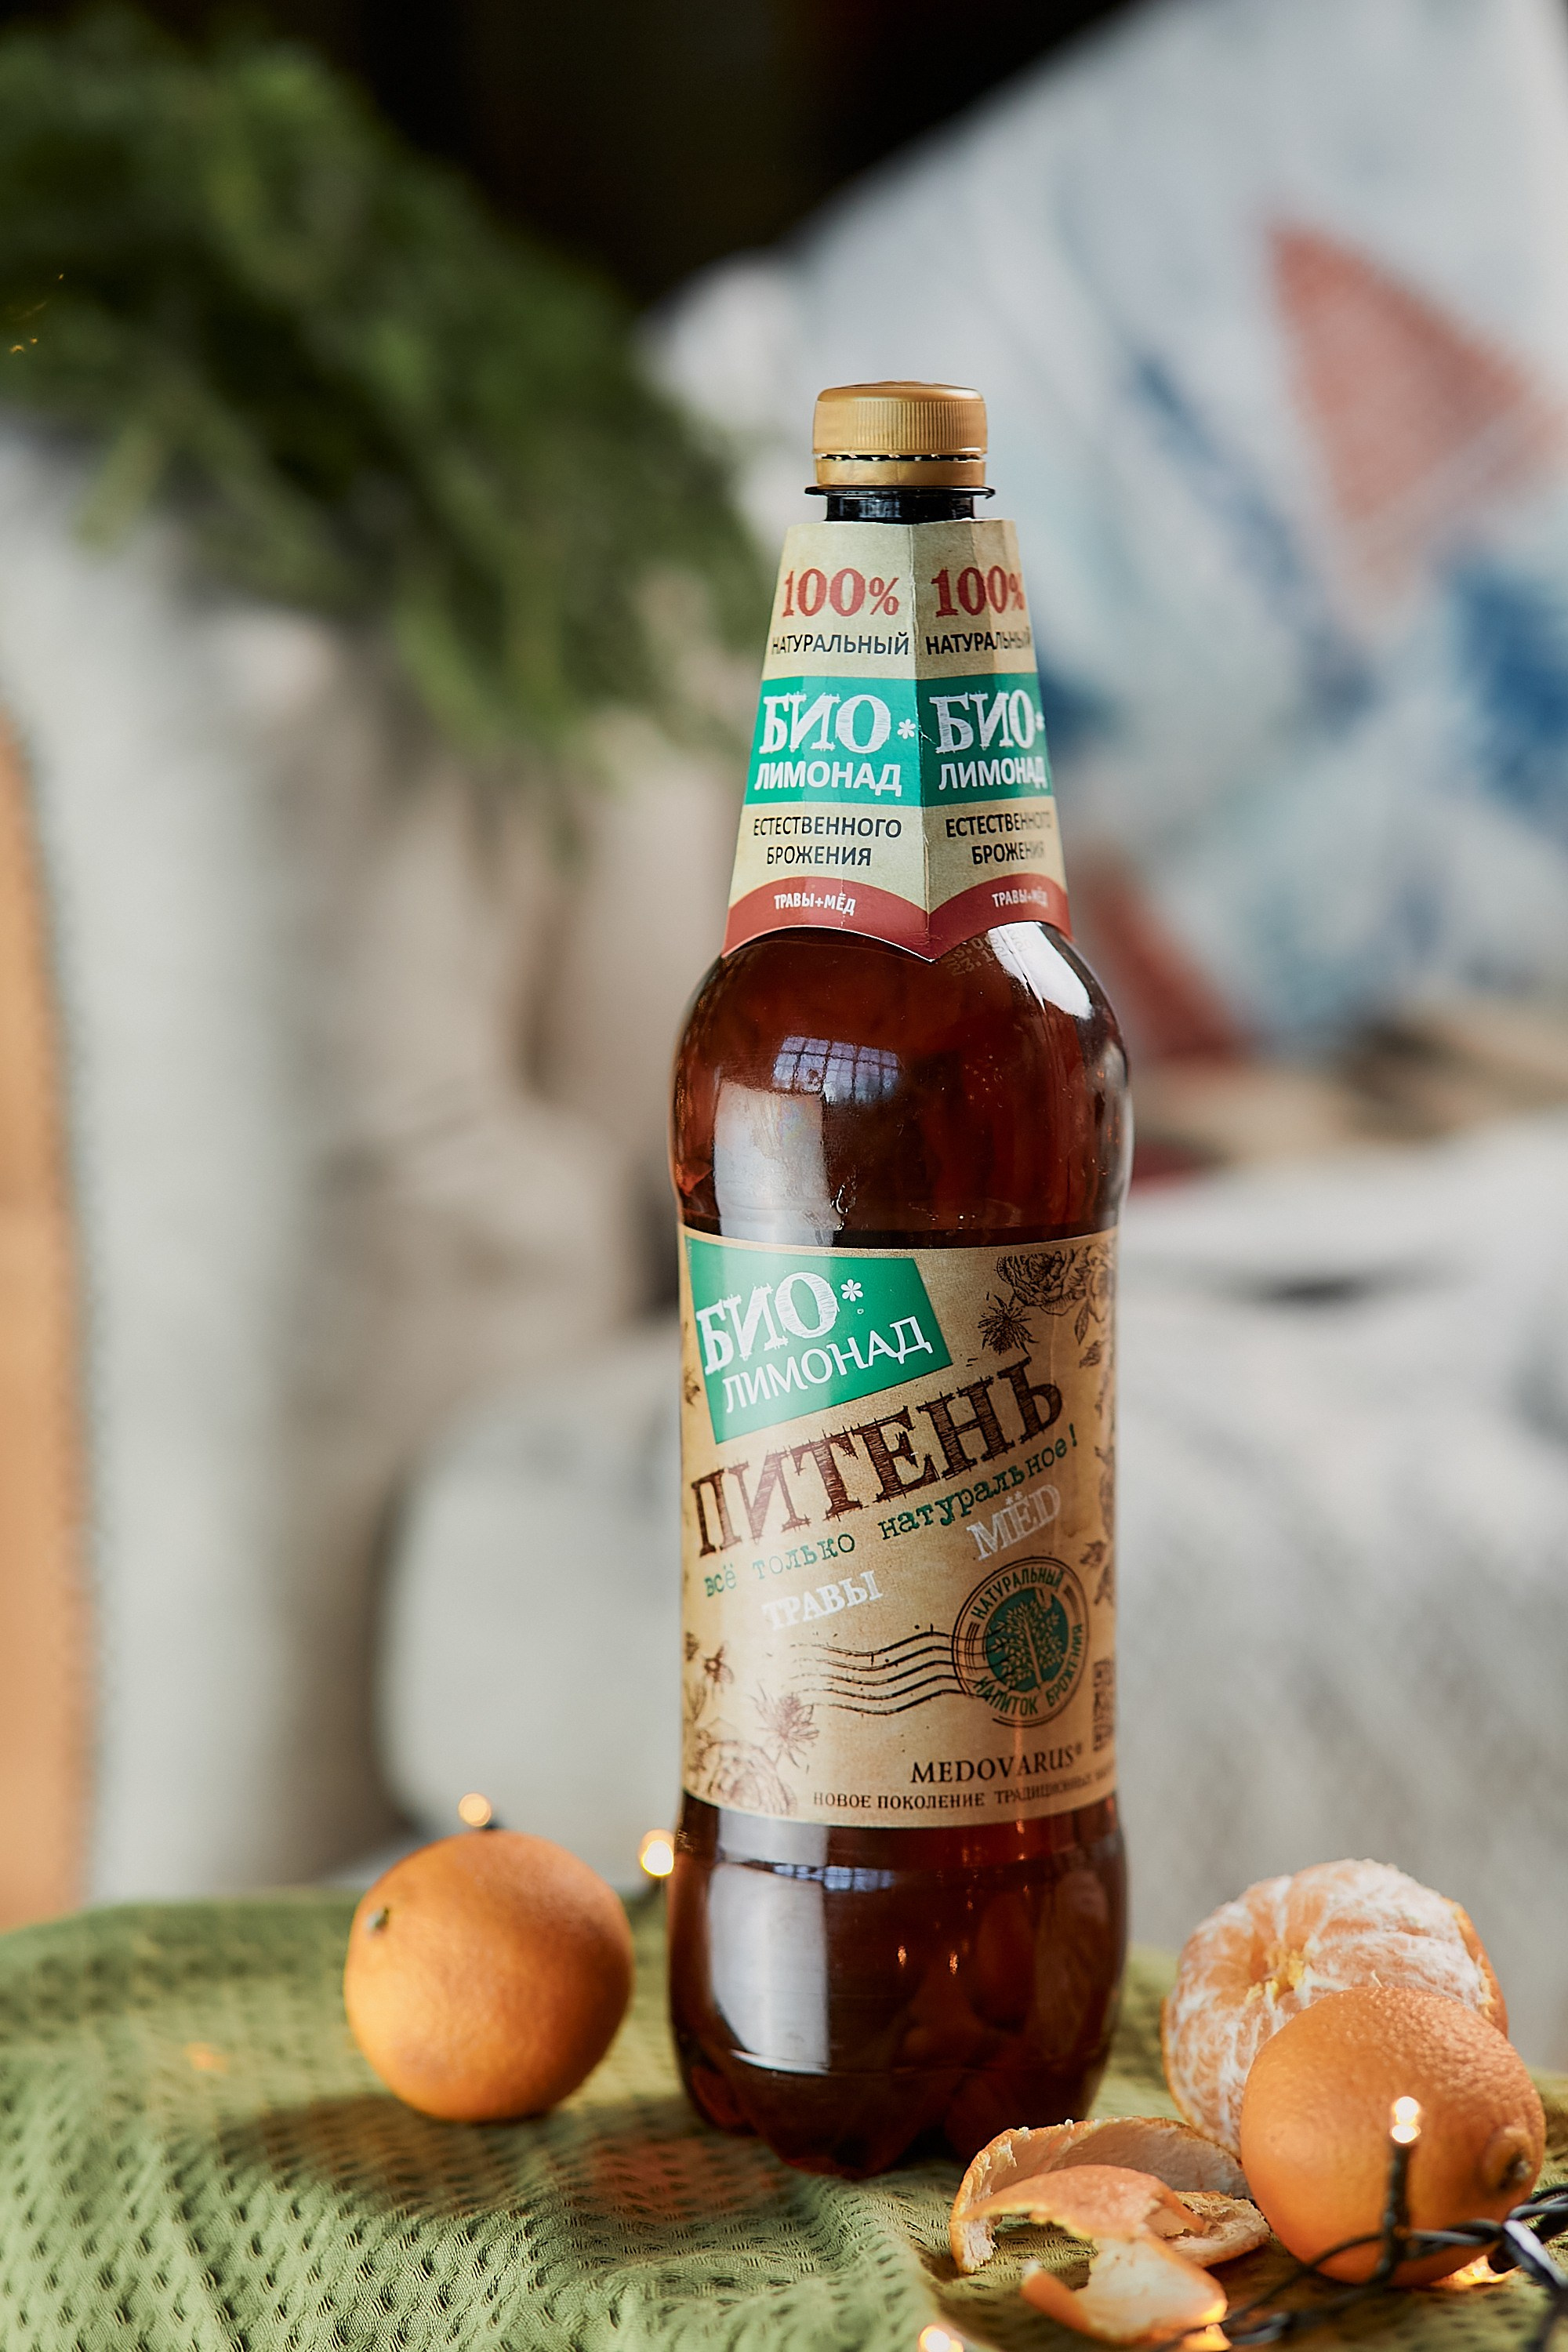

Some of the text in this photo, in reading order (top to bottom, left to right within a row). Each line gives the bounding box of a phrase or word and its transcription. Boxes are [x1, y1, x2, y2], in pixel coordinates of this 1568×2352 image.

[782, 568, 899, 617] 100%
[930, 564, 1025, 618] 100%
[771, 631, 909, 655] НАТУРАЛЬНЫЙ
[753, 760, 902, 797] ЛИМОНАД
[938, 756, 1048, 790] ЛИМОНАД
[753, 815, 902, 838] ЕСТЕСТВЕННОГО
[766, 845, 872, 866] БРОЖЕНИЯ
[774, 892, 856, 916] ТРАВЫ+МЁД
[721, 1316, 934, 1414] ЛИМОНАД
[691, 1356, 1063, 1559] ПИТЕНЬ
[704, 1422, 1078, 1598] всё только натуральное!
[760, 1570, 884, 1632] ТРАВЫ
[813, 1791, 872, 1809] НОВОЕ
[877, 1791, 985, 1810] ПОКОЛЕНИЕ
